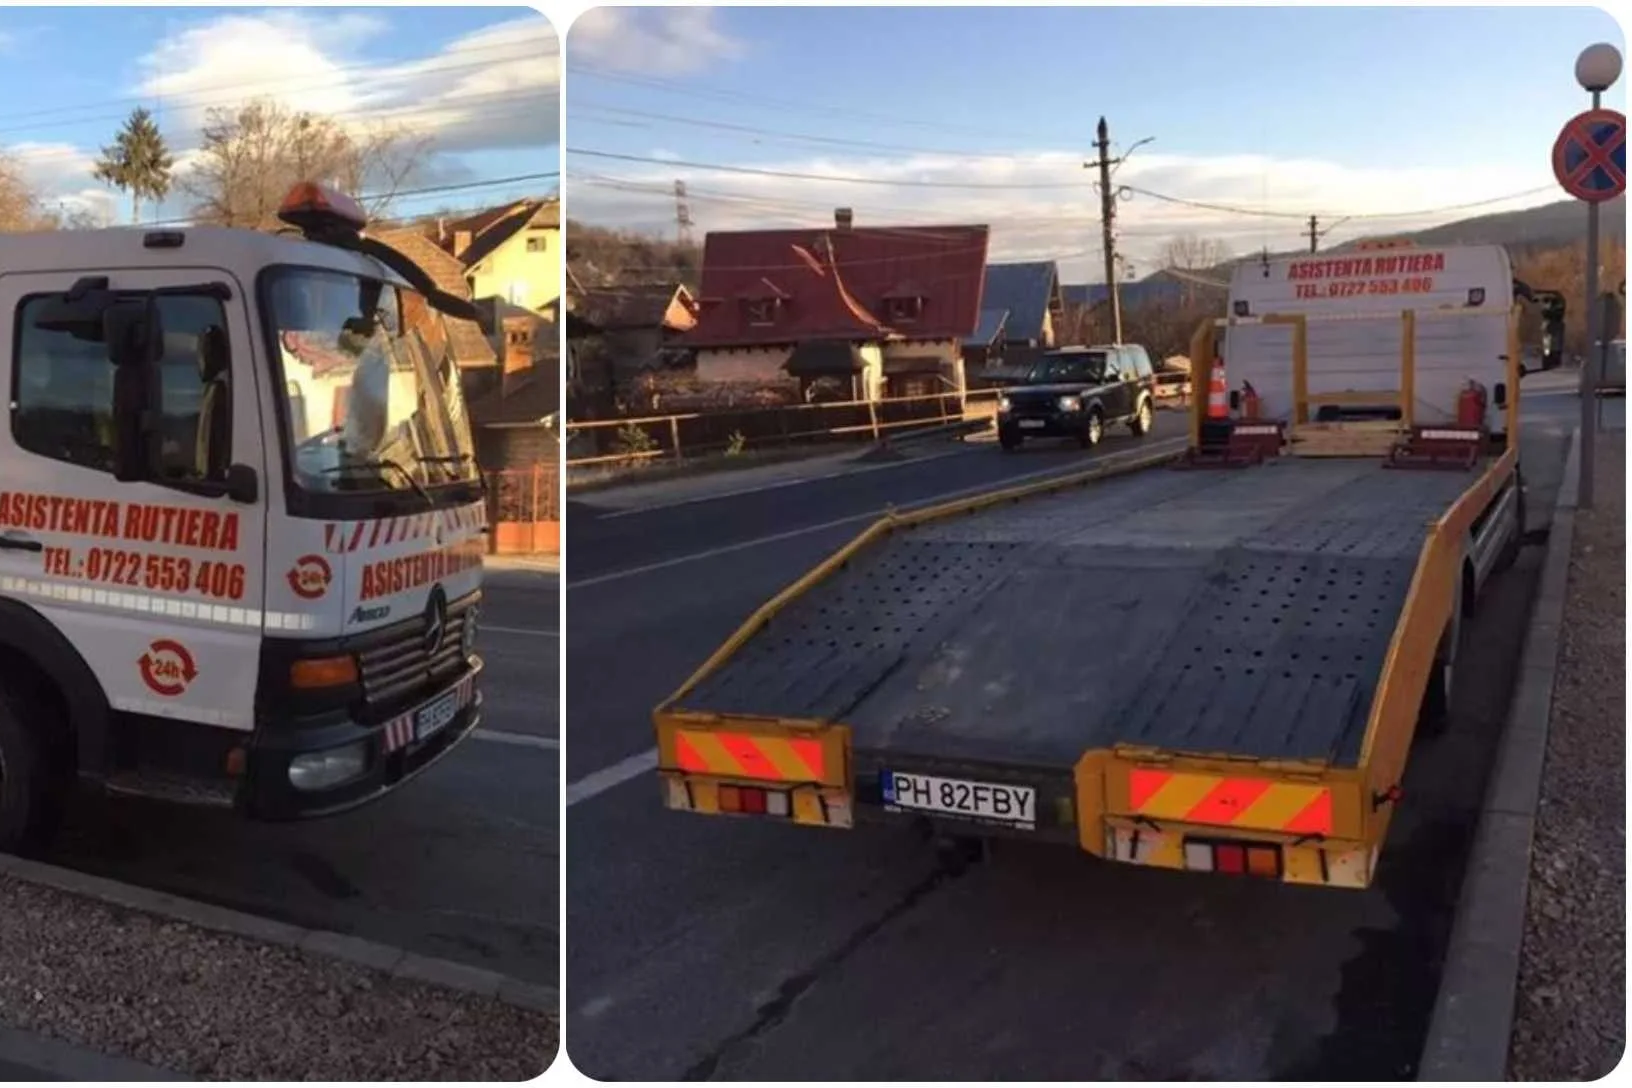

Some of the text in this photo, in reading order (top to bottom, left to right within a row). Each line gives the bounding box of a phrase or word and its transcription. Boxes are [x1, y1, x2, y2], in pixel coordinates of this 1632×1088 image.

[1288, 252, 1445, 280] ASISTENTA RUTIERA
[1328, 282, 1366, 298] 0722
[124, 504, 239, 551] RUTIERA
[87, 547, 141, 586] 0722
[145, 556, 191, 592] 553
[195, 559, 245, 600] 406
[360, 549, 445, 601] ASISTENTA
[895, 775, 1030, 817] PH 82FBY
